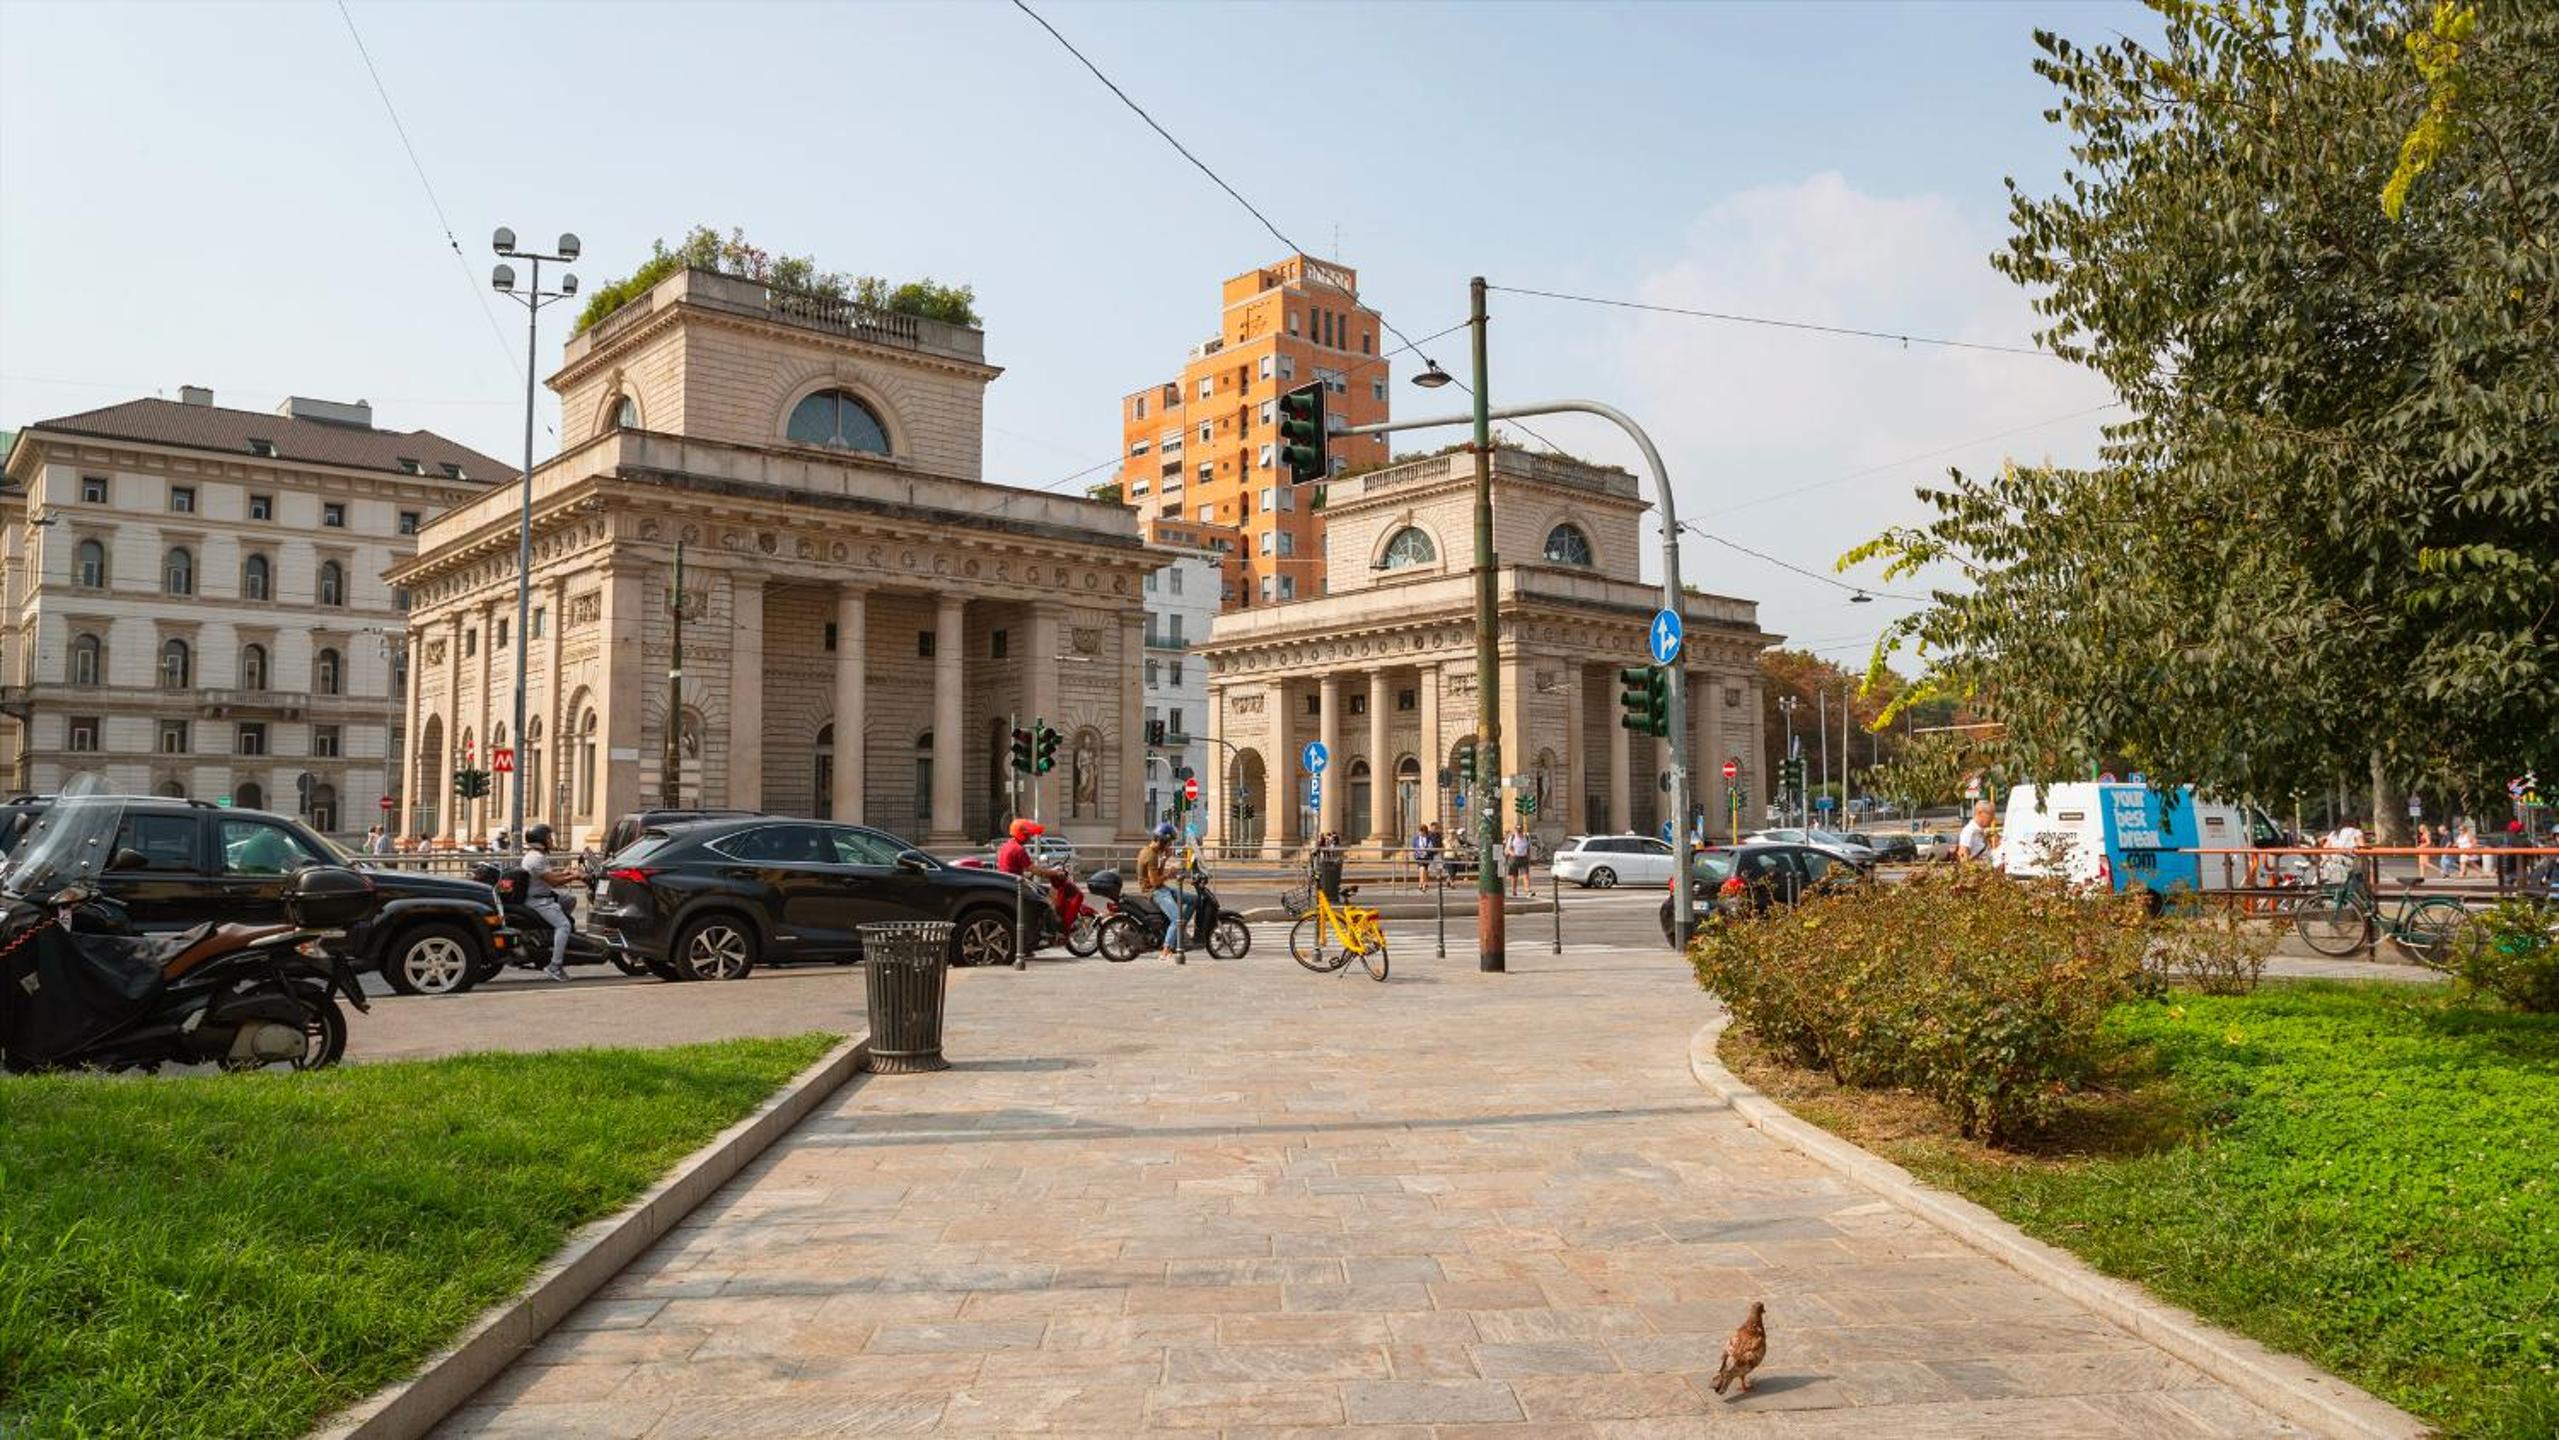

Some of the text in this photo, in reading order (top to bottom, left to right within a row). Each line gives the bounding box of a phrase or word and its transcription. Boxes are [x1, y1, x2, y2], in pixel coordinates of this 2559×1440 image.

[495, 754, 514, 768] M
[2111, 790, 2145, 808] your
[2114, 808, 2147, 828] best
[2118, 829, 2161, 849] break
